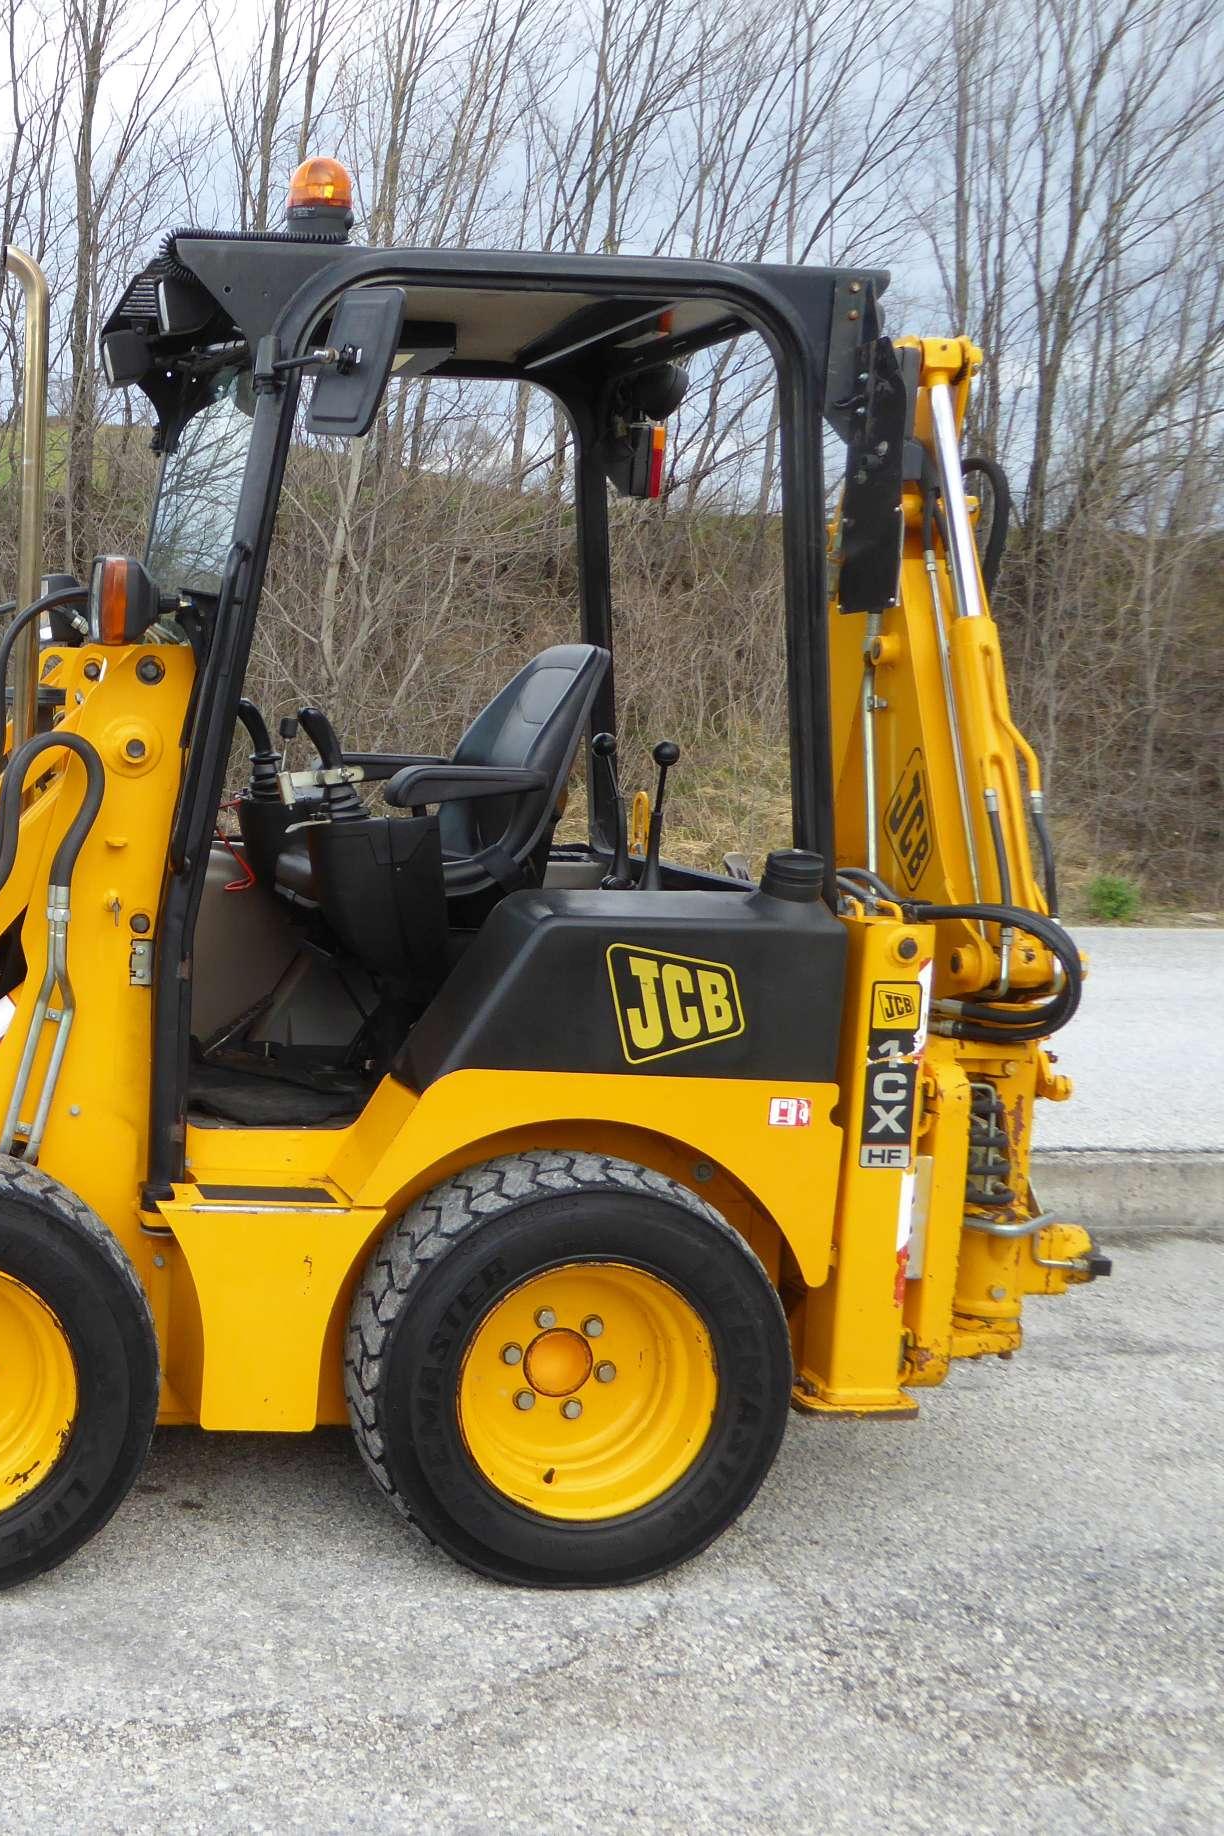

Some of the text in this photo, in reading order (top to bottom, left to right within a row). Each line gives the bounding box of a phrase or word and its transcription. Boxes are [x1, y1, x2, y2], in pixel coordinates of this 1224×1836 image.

[889, 769, 929, 879] JCB
[626, 955, 734, 1050] JCB
[883, 992, 915, 1020] JCB
[867, 1039, 908, 1135] 1CX
[867, 1149, 903, 1165] HF
